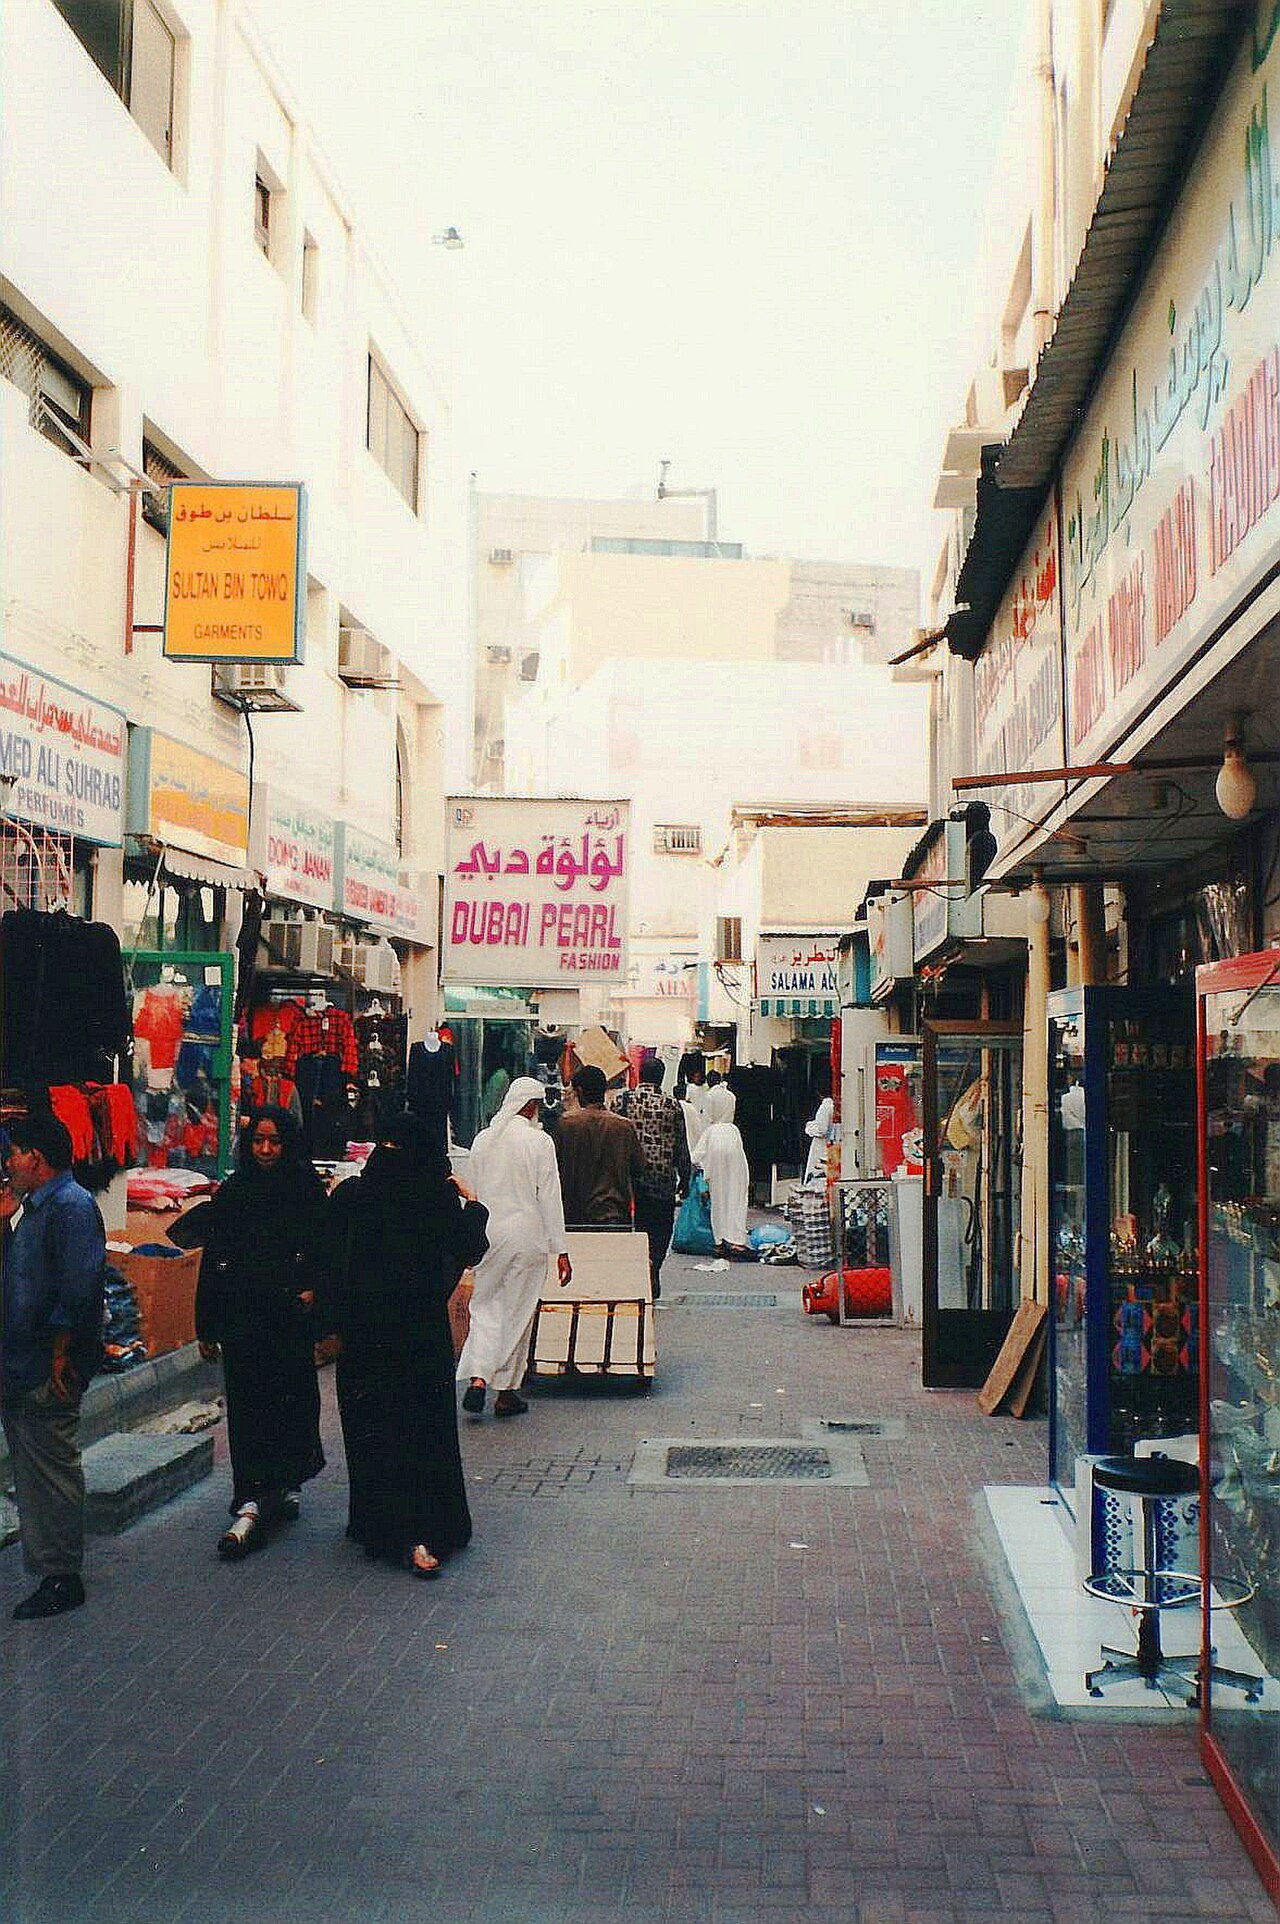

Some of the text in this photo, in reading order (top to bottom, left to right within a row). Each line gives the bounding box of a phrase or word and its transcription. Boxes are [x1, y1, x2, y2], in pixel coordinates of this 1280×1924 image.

[1207, 343, 1280, 578] TRADING
[175, 502, 294, 523] سلطان بن طوق
[172, 571, 288, 601] SULTAN BIN TOWQ
[194, 624, 263, 641] GARMENTS
[37, 744, 60, 792] ALI
[65, 758, 121, 812] SUHRAB
[17, 786, 85, 828] PERFUMES
[453, 841, 530, 881] دبي
[535, 833, 624, 891] لؤلؤة
[451, 901, 530, 945] DUBAI
[539, 903, 622, 948] PEARL
[560, 953, 620, 970] FASHION
[771, 972, 815, 991] SALAMA
